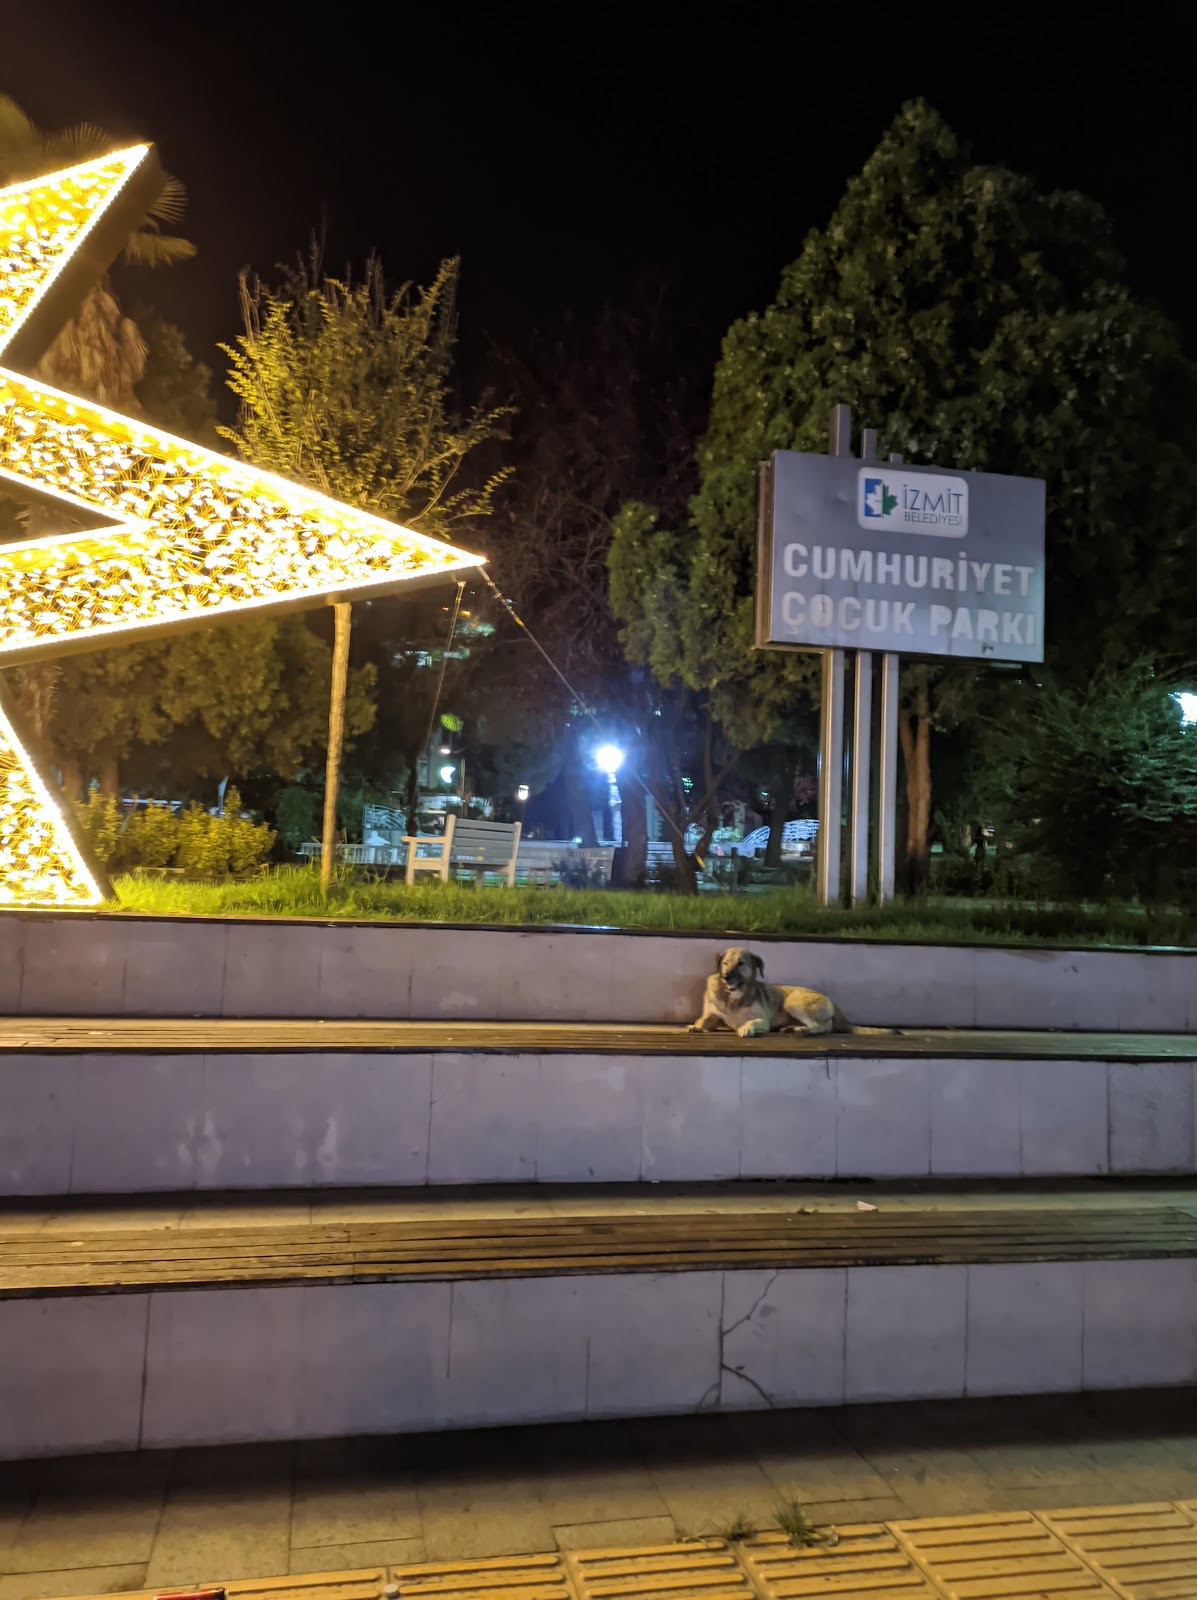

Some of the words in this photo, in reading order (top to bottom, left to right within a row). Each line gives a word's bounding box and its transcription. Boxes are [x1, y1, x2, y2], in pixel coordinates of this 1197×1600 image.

[903, 484, 964, 514] İZMİT
[783, 542, 1035, 597] CUMHURİYET
[781, 591, 917, 635] ÇOCUK
[929, 604, 1036, 645] PARKI
